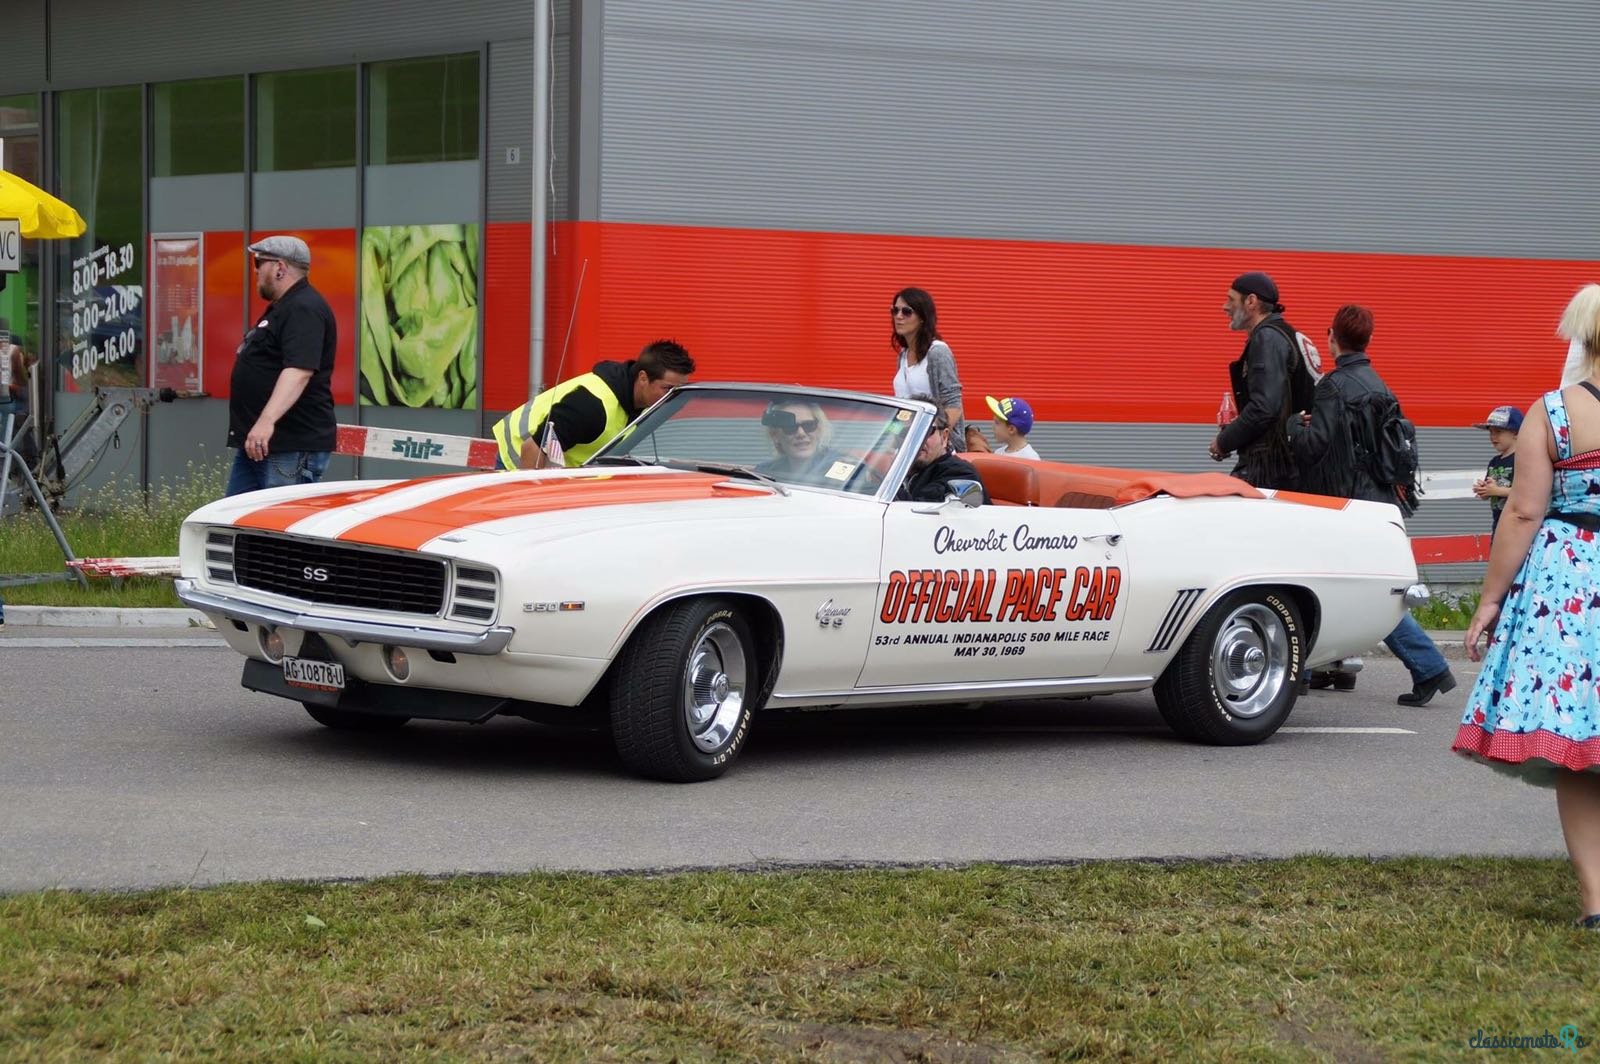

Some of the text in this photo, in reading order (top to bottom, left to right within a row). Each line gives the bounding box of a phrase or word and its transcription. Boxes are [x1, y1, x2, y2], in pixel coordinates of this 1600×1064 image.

[509, 147, 516, 162] 6
[934, 524, 1078, 554] Chevrolet Camaro
[303, 566, 328, 582] SS
[880, 566, 1121, 624] OFFICIAL PACE CAR
[523, 601, 558, 612] 350
[875, 631, 1110, 646] 53rd ANNUAL INDIANAPOLIS 500 MILE RACE
[1266, 595, 1300, 682] COOPER COBRA
[954, 646, 981, 657] MAY
[726, 708, 751, 756] RADIAL
